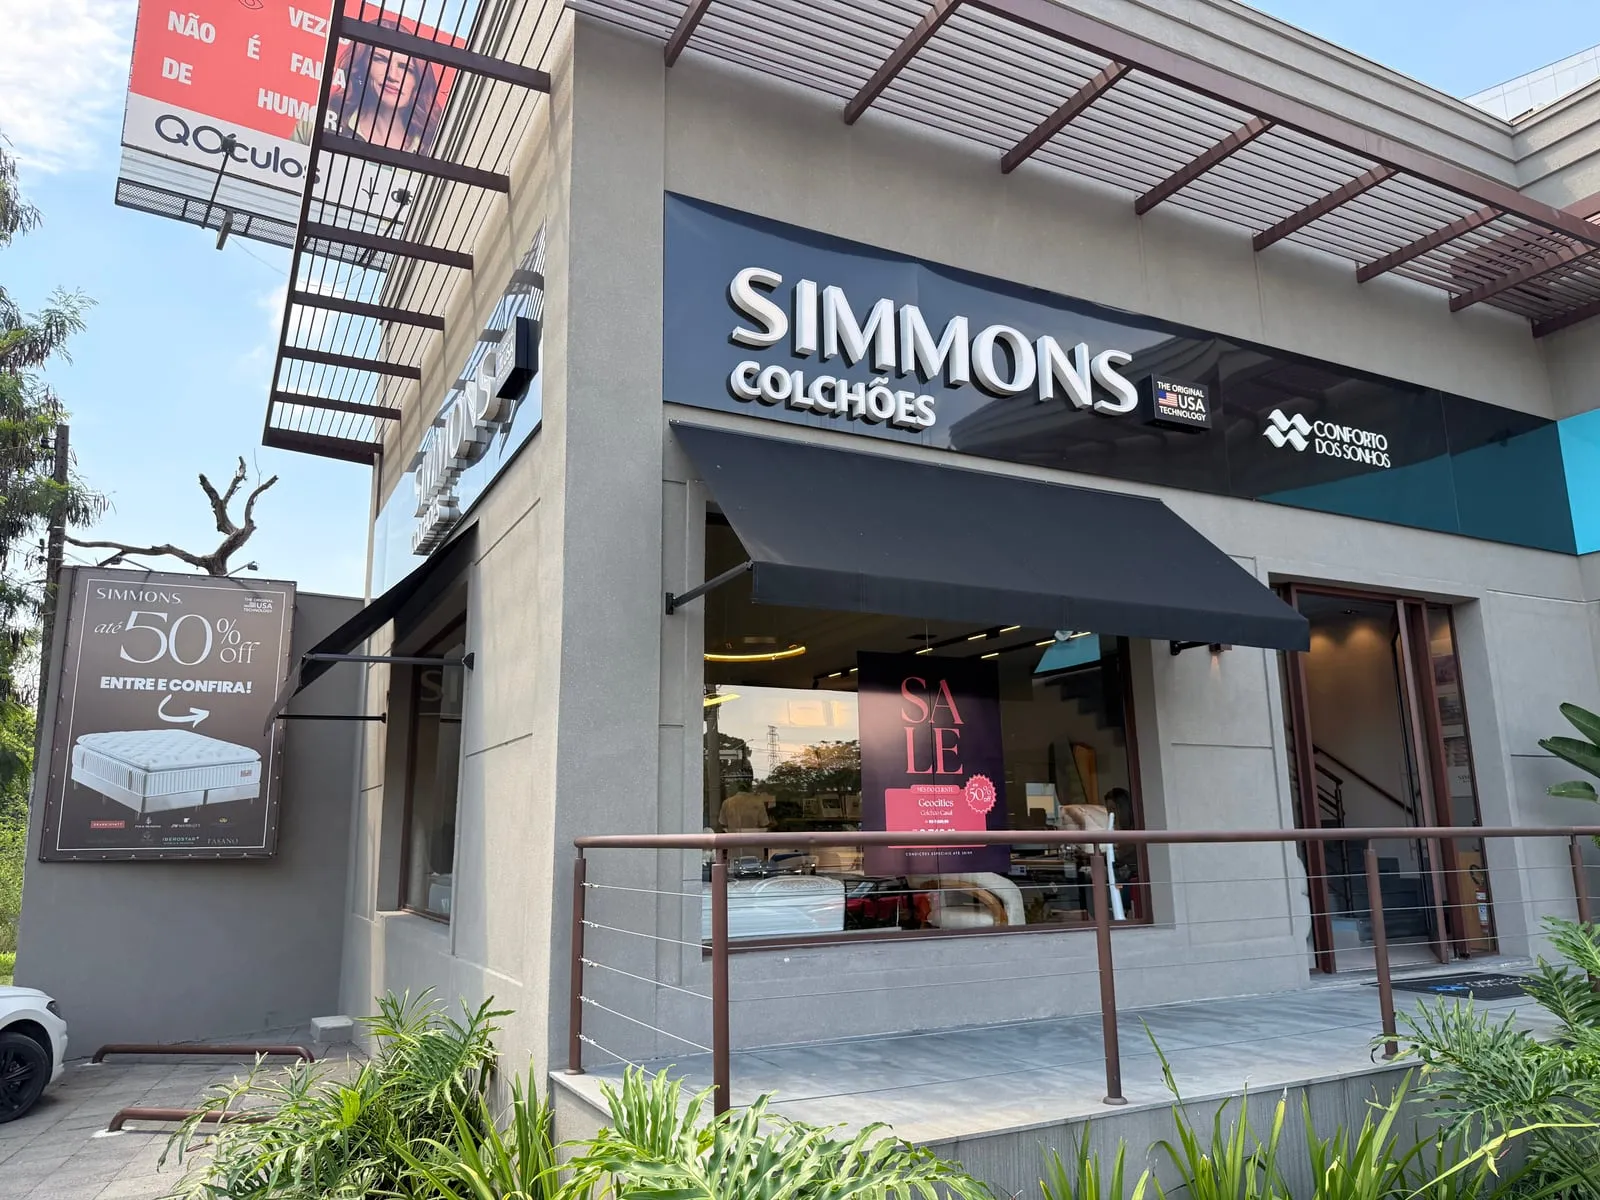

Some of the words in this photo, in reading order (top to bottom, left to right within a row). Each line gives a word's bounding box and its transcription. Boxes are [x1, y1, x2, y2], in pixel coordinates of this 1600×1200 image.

[288, 6, 351, 46] VEZ
[167, 11, 216, 44] NÃO
[247, 34, 261, 60] É
[290, 52, 347, 89] FALA
[162, 57, 194, 86] DE
[729, 266, 1139, 416] SIMMONS
[730, 360, 937, 430] COLCHÕES
[1157, 381, 1171, 392] THE
[1172, 384, 1204, 398] ORIGINAL
[1178, 394, 1206, 413] USA
[1158, 405, 1206, 422] TECHNOLOGY
[1313, 420, 1388, 450] CONFORTO
[1315, 438, 1342, 458] DOS
[1343, 446, 1391, 468] SONHOS
[96, 587, 181, 604] SIMMONS
[94, 620, 124, 635] até
[219, 641, 261, 664] off
[100, 676, 152, 690] ENTRE
[157, 677, 169, 691] E
[169, 679, 253, 694] CONFIRA!
